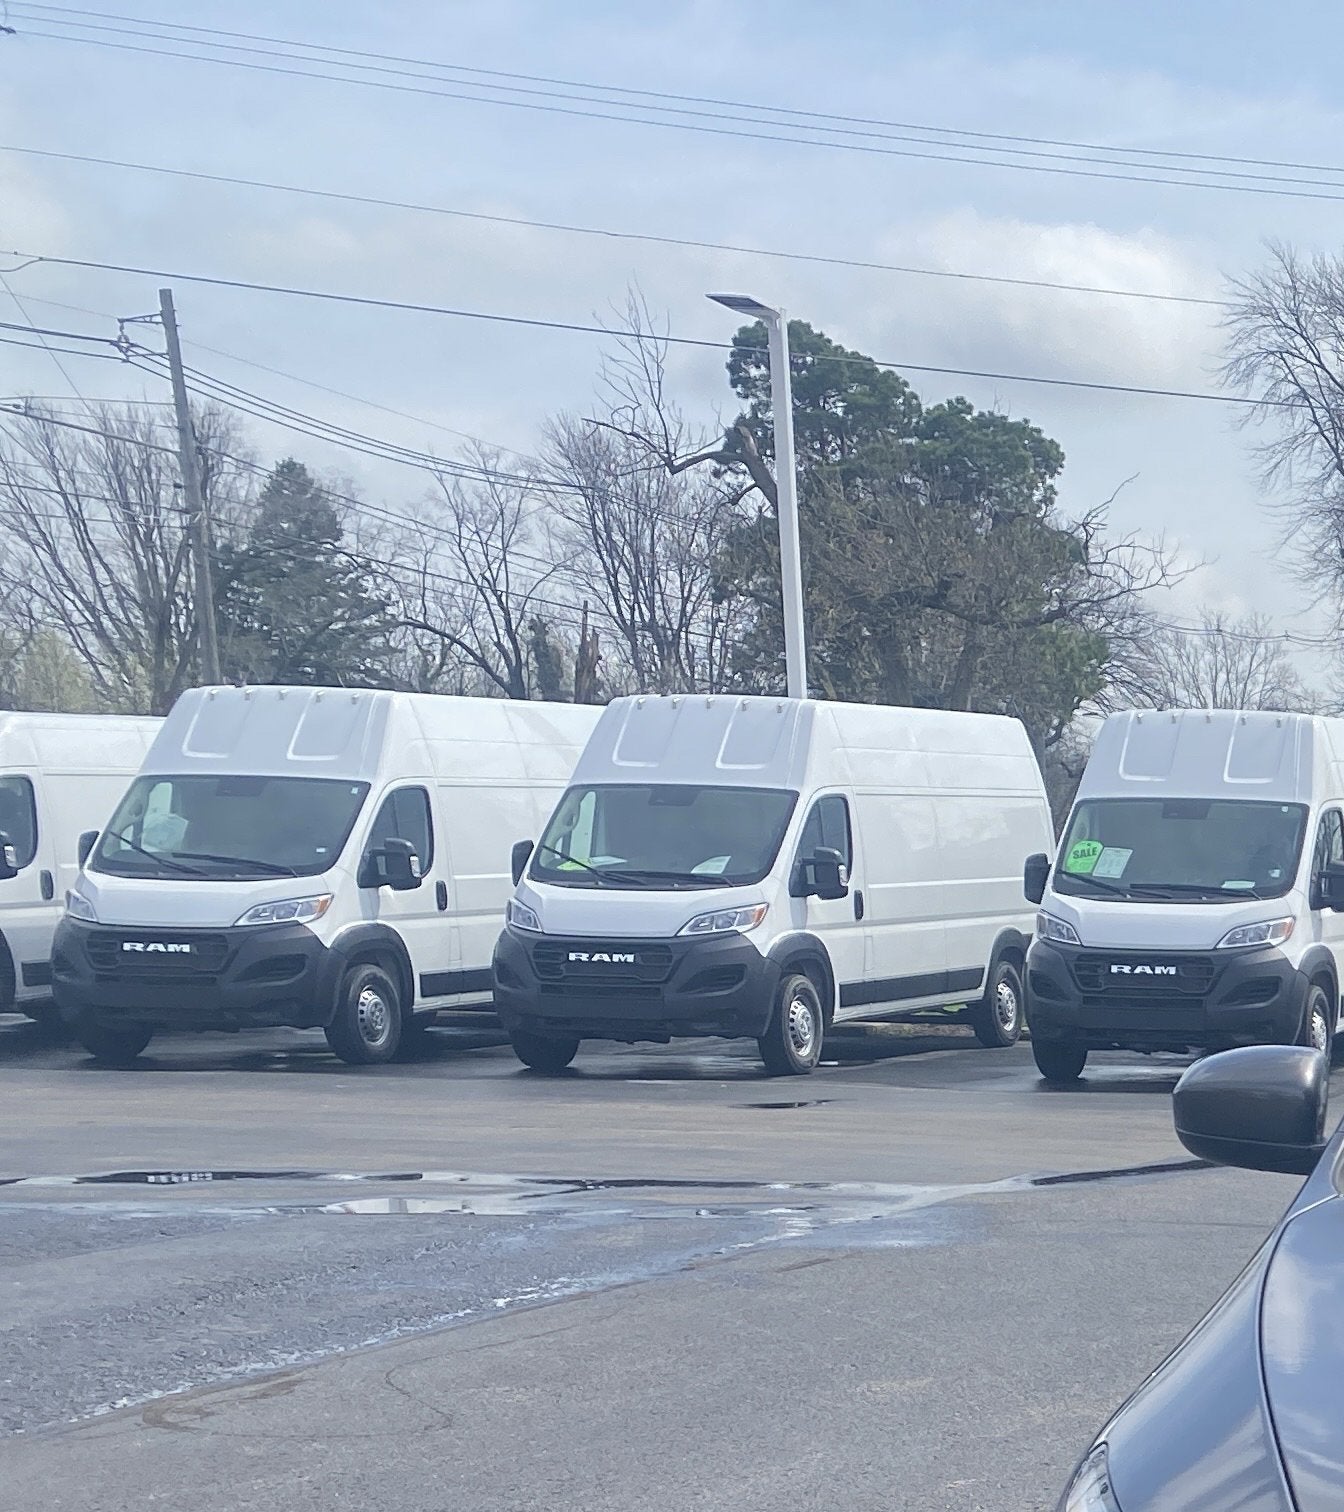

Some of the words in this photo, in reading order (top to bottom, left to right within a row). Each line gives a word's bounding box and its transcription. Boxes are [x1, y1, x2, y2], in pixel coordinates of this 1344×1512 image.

[1073, 847, 1098, 860] SALE
[122, 942, 191, 953] RAM
[568, 952, 635, 963] RAM
[1110, 964, 1177, 975] RAM
